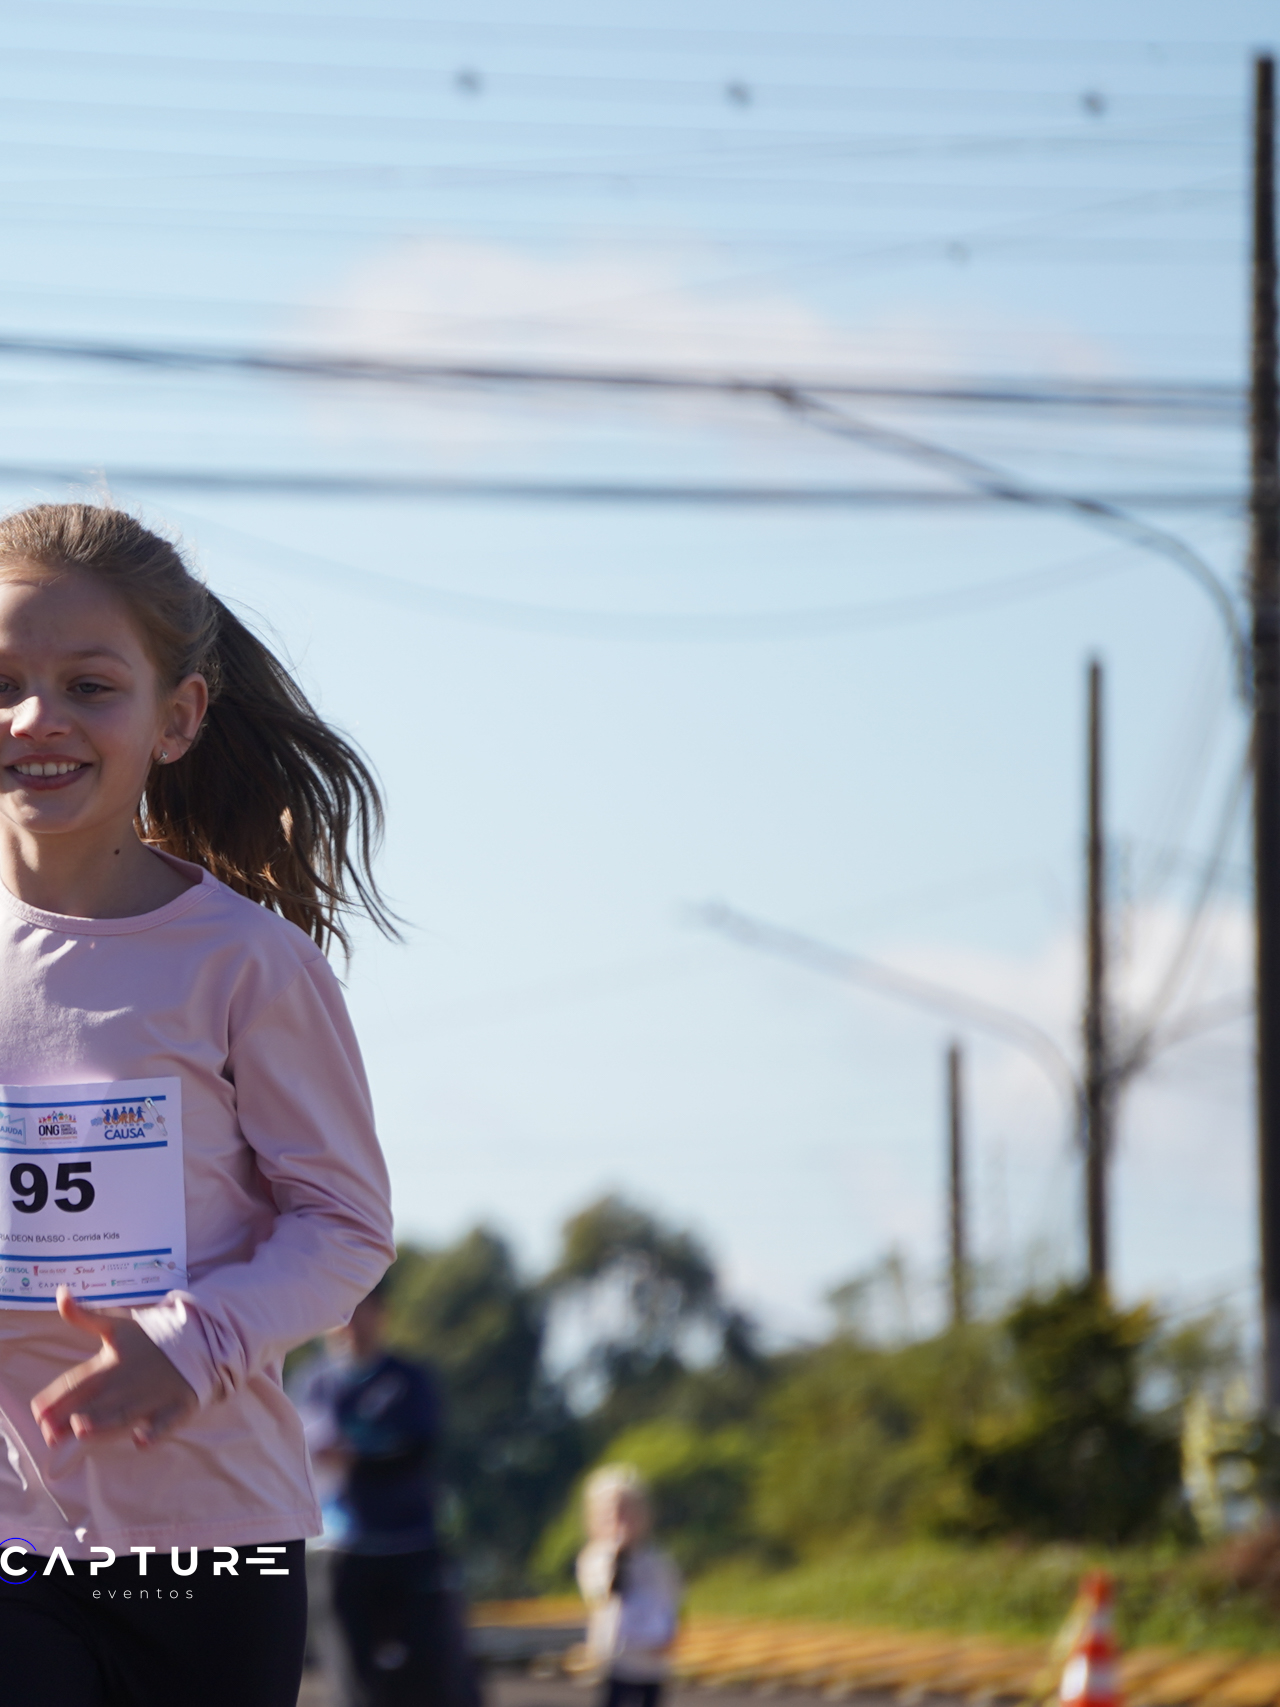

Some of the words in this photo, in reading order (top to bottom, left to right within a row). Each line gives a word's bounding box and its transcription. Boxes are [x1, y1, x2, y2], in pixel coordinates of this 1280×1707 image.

[103, 1112, 146, 1126] CORRA
[0, 1126, 23, 1136] AJUDA
[38, 1124, 60, 1136] ONG
[104, 1127, 146, 1140] CAUSA
[11, 1234, 34, 1243] DEON
[35, 1234, 66, 1243] BASSO
[72, 1232, 101, 1242] Corrida
[103, 1231, 120, 1240] Kids
